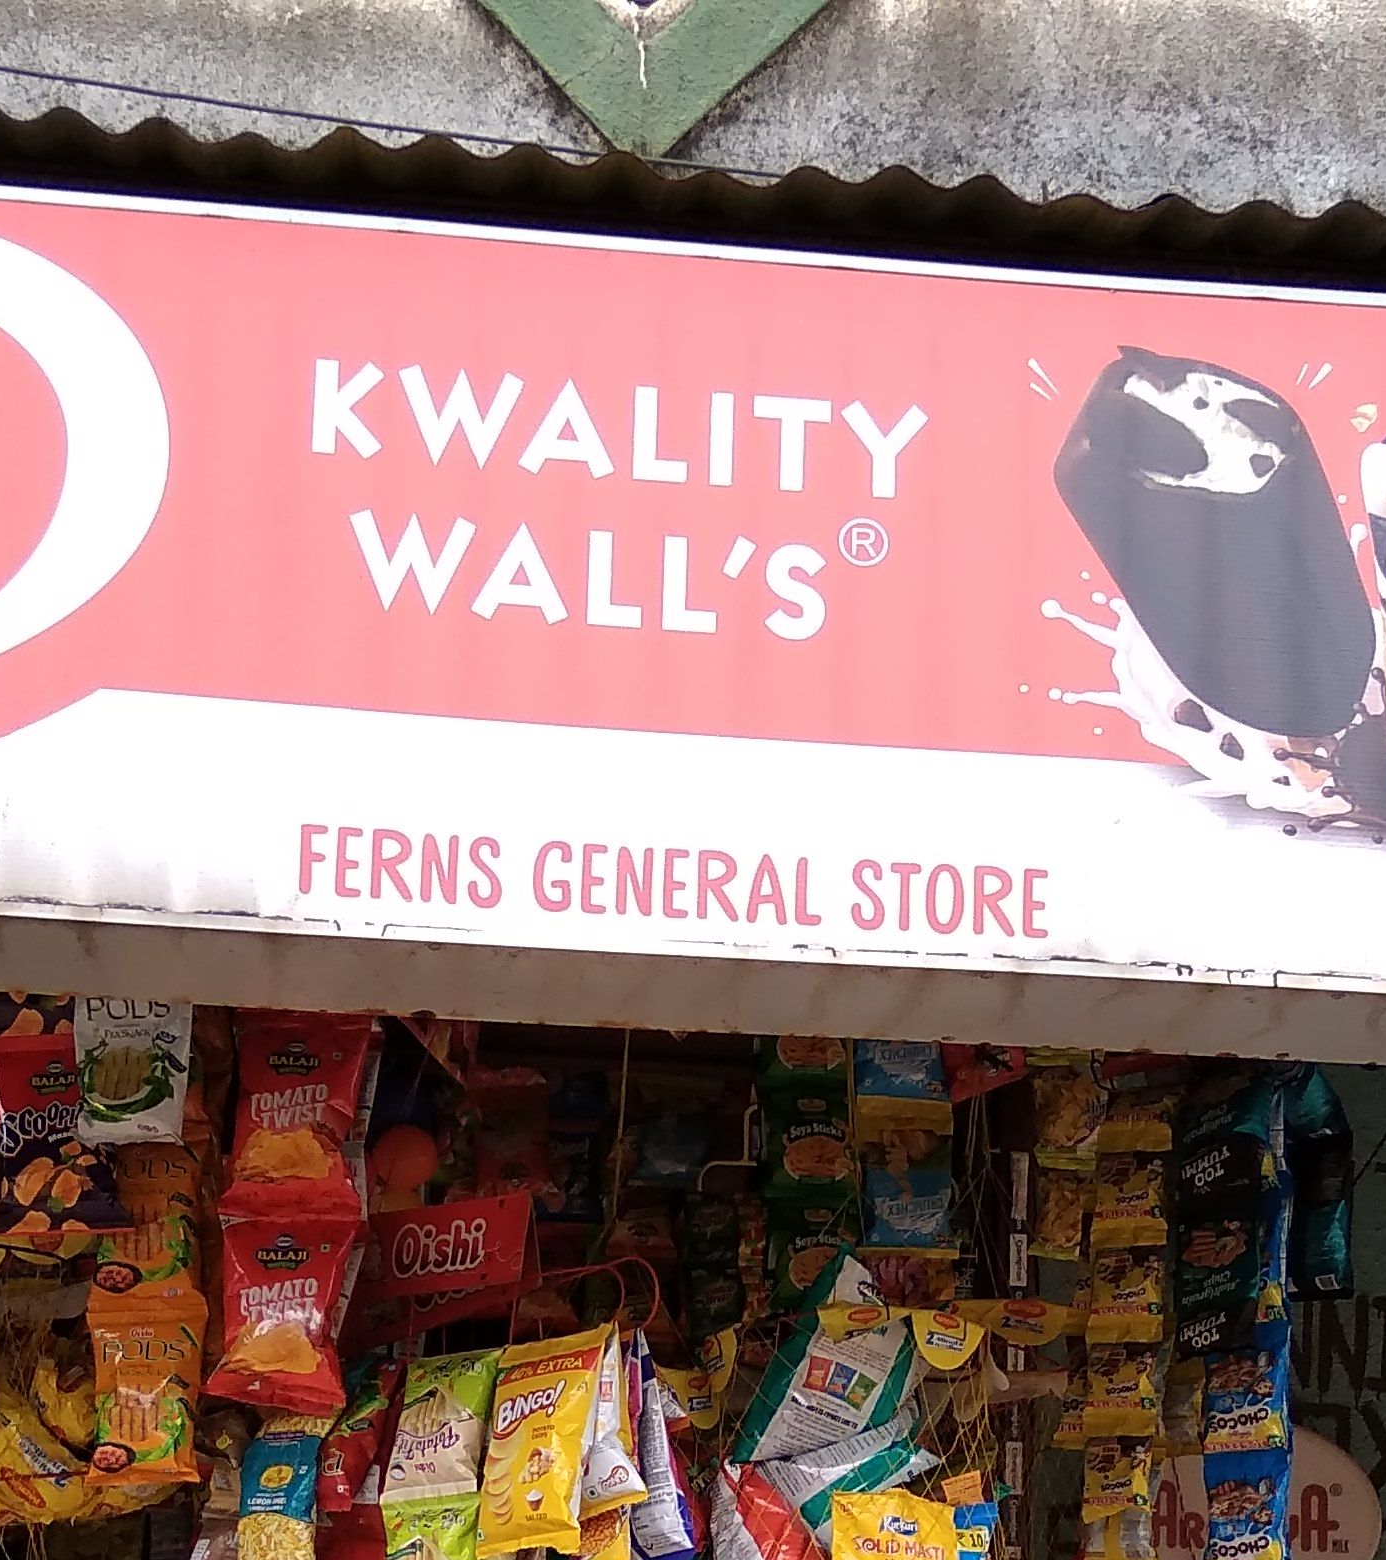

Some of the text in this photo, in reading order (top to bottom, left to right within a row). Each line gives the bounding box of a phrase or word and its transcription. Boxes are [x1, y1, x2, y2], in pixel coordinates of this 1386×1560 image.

[310, 357, 929, 500] KWALITY
[298, 823, 1050, 938] FERNS GENERAL STORE
[268, 1055, 319, 1067] BALAJI
[250, 1083, 330, 1120] TOMATO
[260, 1102, 326, 1129] TWIST
[1194, 1167, 1226, 1188] TOO
[257, 1250, 308, 1262] BALAJI
[391, 1217, 487, 1279] Oishi
[239, 1277, 319, 1314] TOMATO
[1192, 1327, 1221, 1349] TOO
[100, 1338, 186, 1364] PODS
[536, 1355, 583, 1375] EXTRA
[496, 1379, 568, 1433] BINGO!
[1208, 1408, 1270, 1433] CHOCOS
[851, 1537, 903, 1556] SOLID
[1211, 1535, 1270, 1559] CHOCOS
